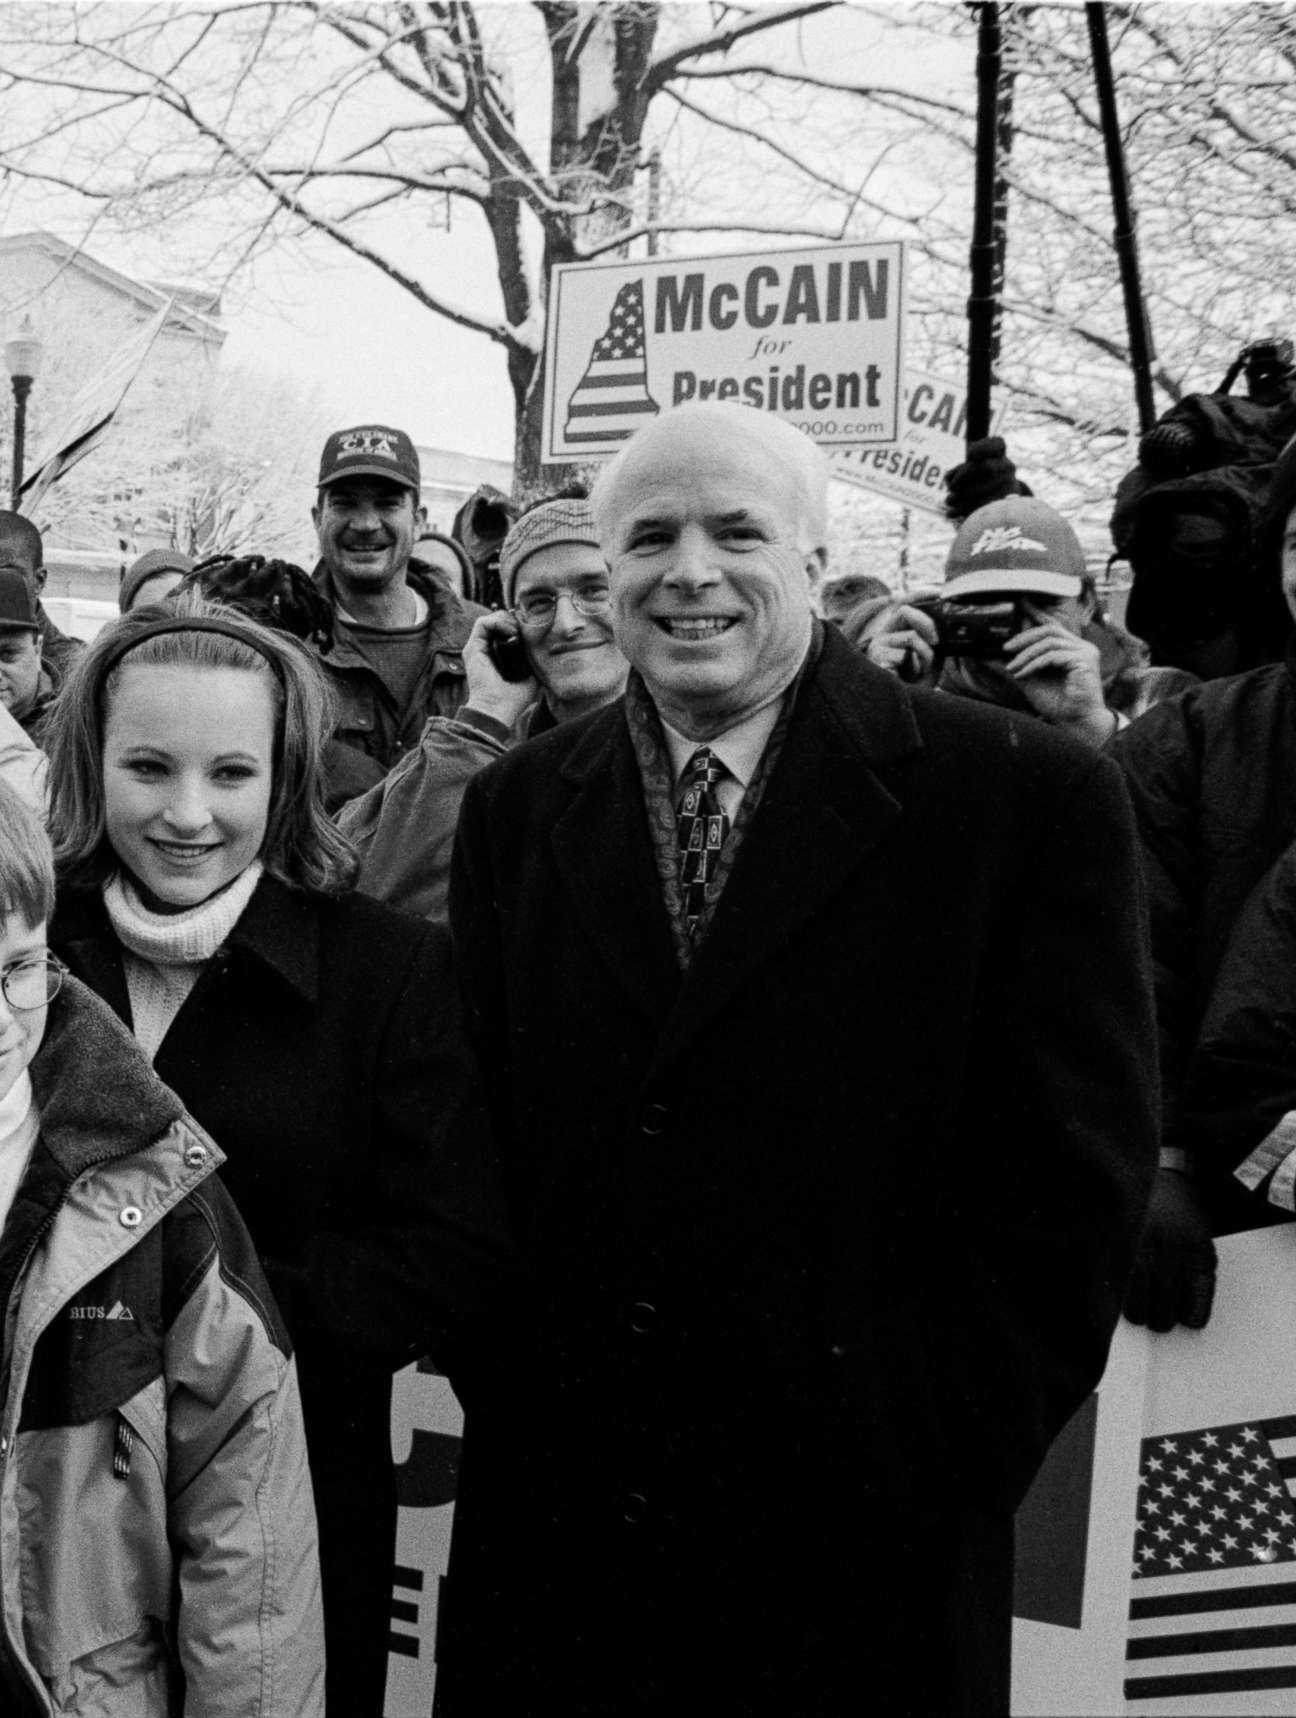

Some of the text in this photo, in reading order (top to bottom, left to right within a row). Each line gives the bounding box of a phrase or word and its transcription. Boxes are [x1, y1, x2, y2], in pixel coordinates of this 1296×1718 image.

[654, 259, 889, 334] McCAIN
[747, 335, 792, 360] for
[672, 364, 882, 412] President
[790, 420, 885, 436] 000.com
[343, 437, 394, 454] CIA
